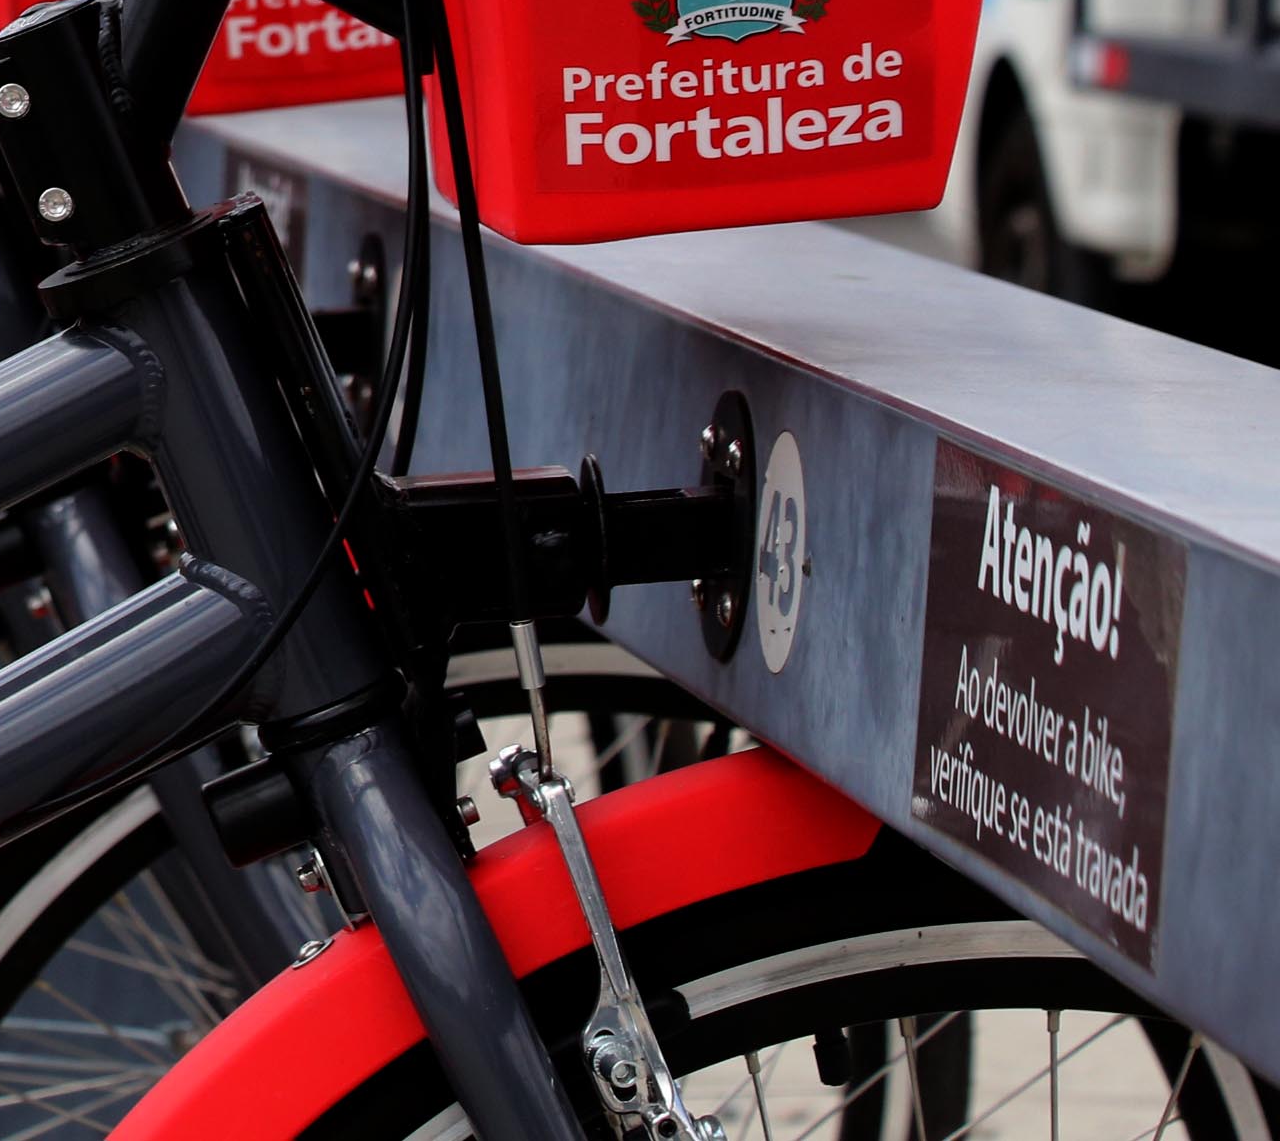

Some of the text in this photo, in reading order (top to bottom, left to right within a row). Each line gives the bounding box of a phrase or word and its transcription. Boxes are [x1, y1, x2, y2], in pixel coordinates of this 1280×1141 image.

[225, 10, 396, 60] Forta
[684, 6, 785, 29] FORTITUDINE
[563, 42, 903, 102] Prefeitura de
[565, 97, 904, 166] Fortaleza
[759, 489, 799, 617] 43
[977, 483, 1126, 666] Atenção!
[954, 643, 1127, 820] Ao devolver a bike,
[930, 744, 1149, 933] verifique se está travada
